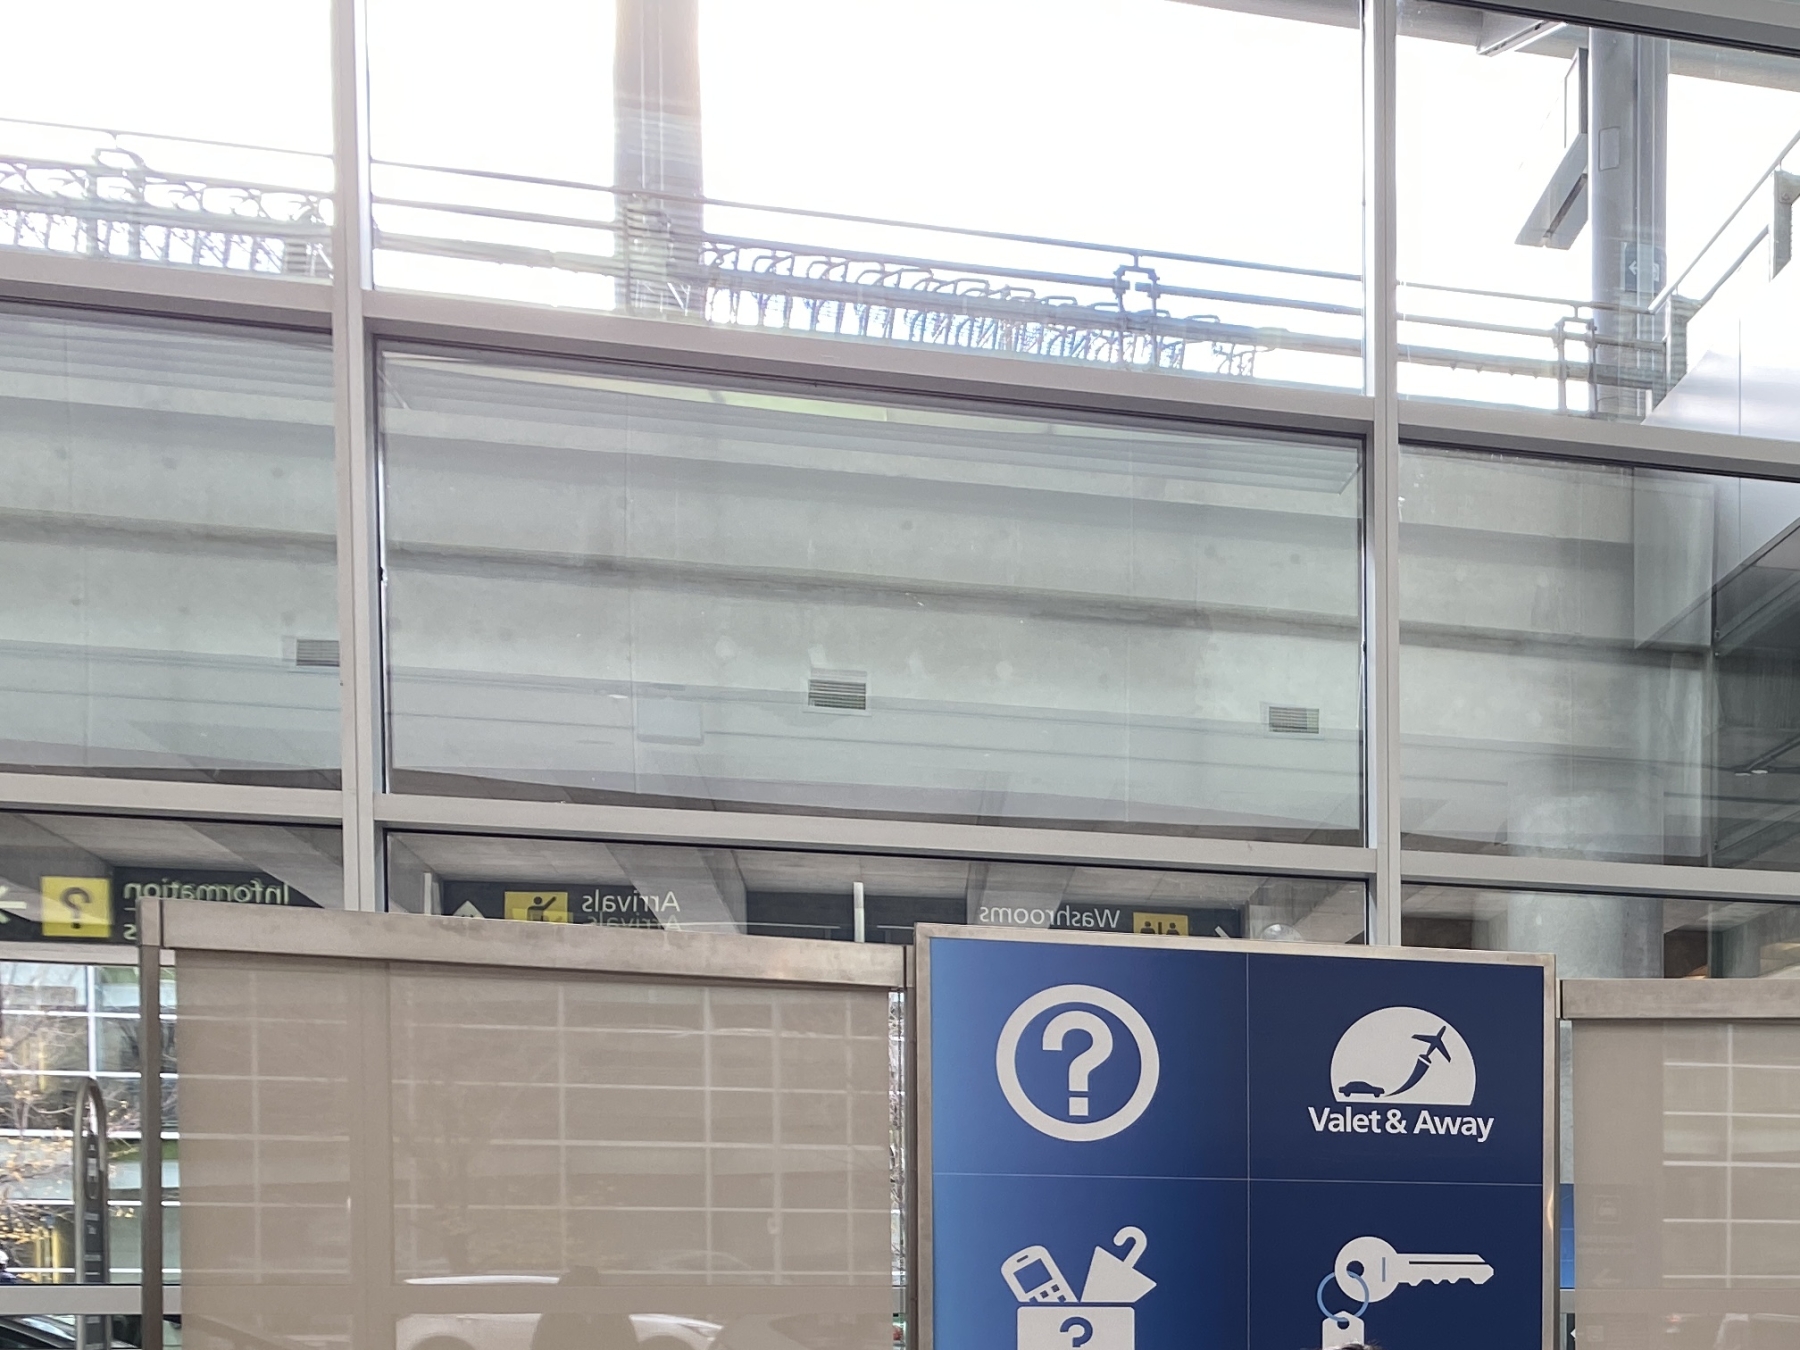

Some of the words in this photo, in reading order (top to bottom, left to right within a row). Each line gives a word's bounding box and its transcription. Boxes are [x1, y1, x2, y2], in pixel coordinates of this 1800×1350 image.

[1307, 1106, 1382, 1133] Valet
[1385, 1108, 1408, 1134] &
[1412, 1110, 1495, 1143] Away
